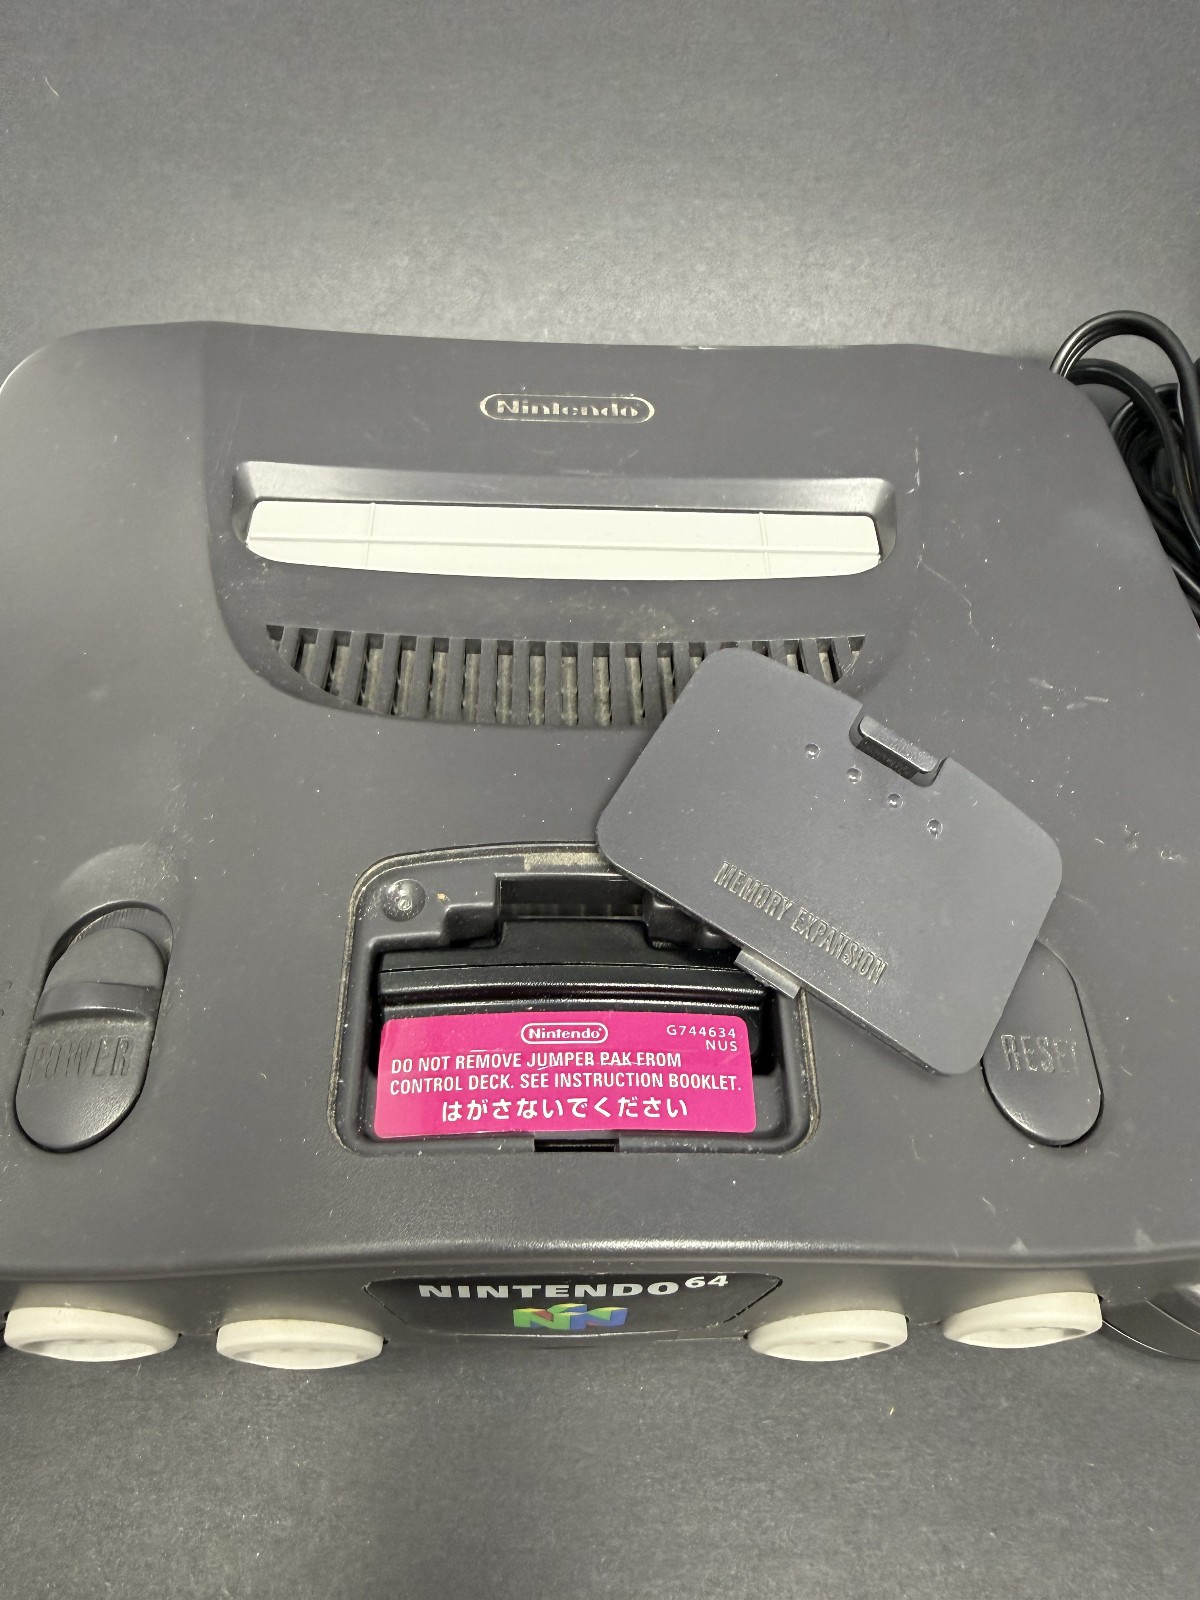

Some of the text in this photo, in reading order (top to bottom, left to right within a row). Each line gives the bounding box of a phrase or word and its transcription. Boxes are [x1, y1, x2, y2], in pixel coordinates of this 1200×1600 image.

[497, 399, 639, 418] Nintendo
[713, 860, 889, 985] MEMORY EXPANSION
[528, 1027, 602, 1040] Nintendo
[666, 1025, 737, 1039] G744634
[705, 1038, 738, 1052] NUS
[391, 1052, 682, 1075] DO NOT REMOVE JUMPER PAK FROM
[390, 1073, 742, 1095] CONTROL DECK. SEE INSTRUCTION BOOKLET.
[442, 1097, 688, 1122] はがさないでください
[418, 1274, 729, 1299] NINTENDO 64
